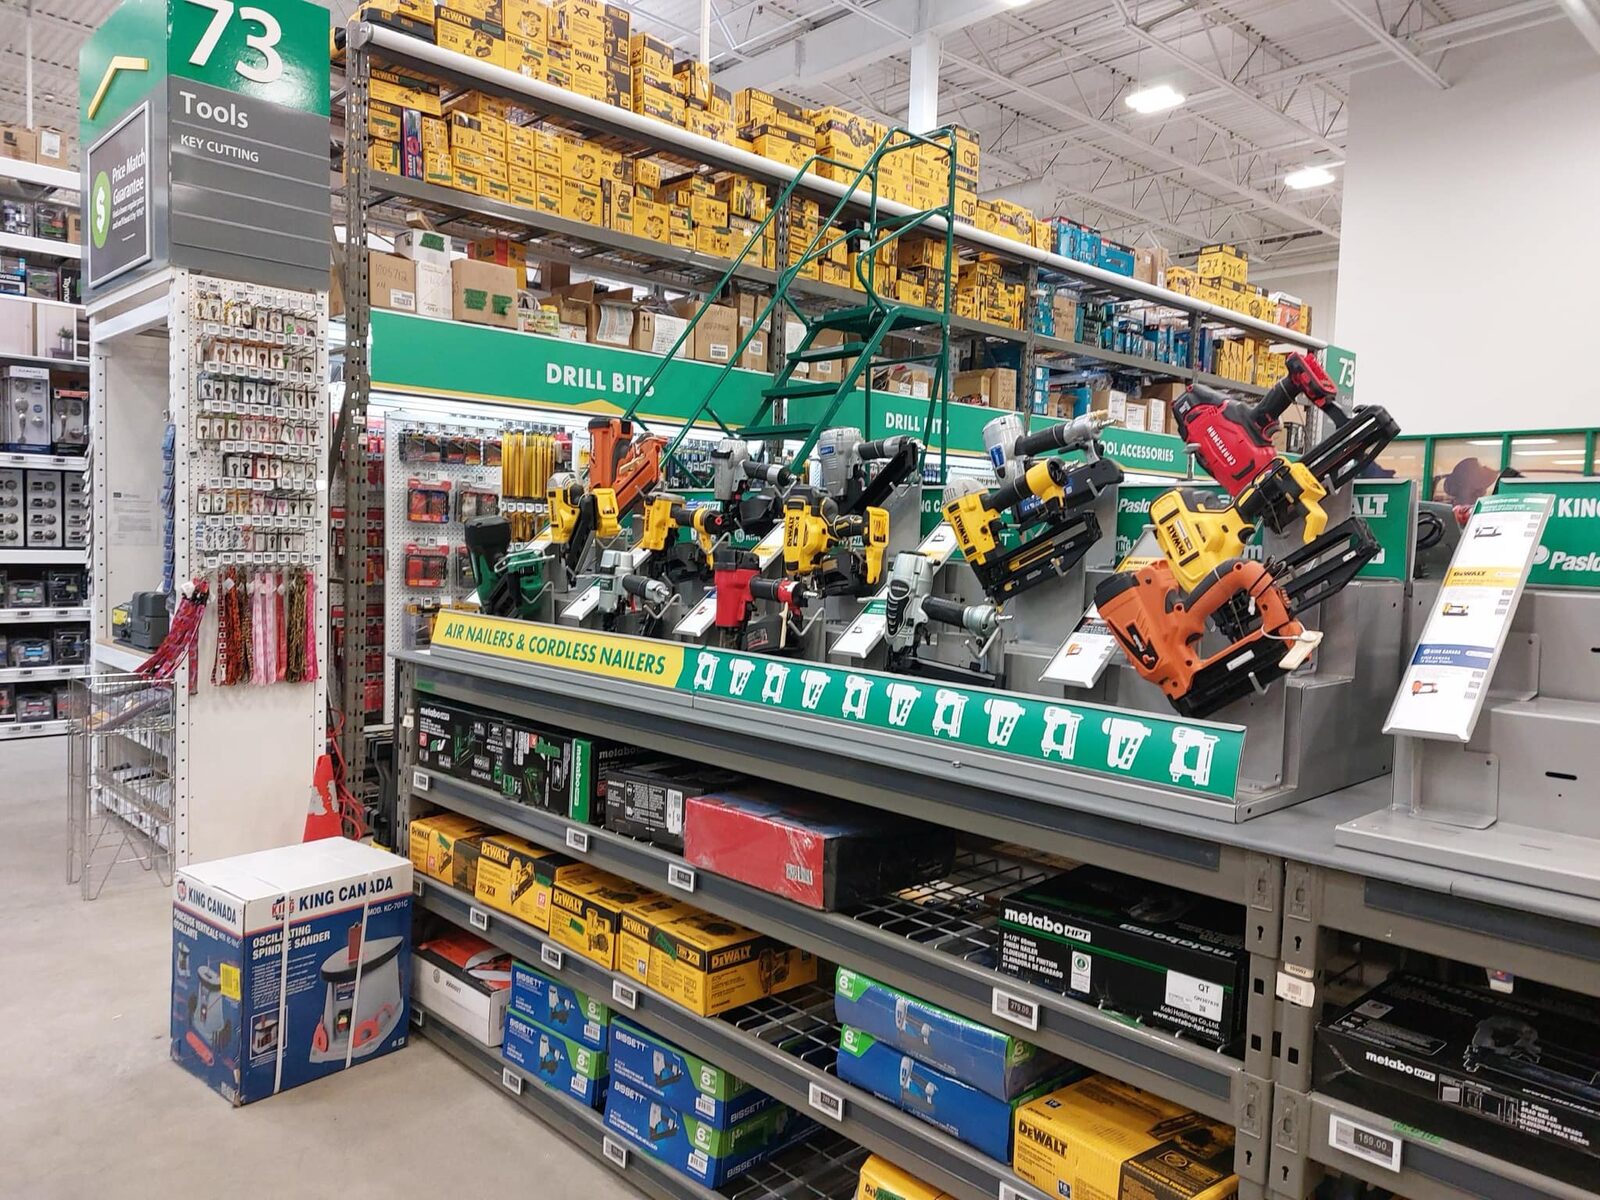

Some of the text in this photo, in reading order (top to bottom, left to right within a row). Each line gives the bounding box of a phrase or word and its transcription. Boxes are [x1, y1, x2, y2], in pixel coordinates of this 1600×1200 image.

[179, 0, 283, 83] 73
[179, 90, 249, 129] Tools
[180, 134, 259, 162] KEY CUTTING
[112, 147, 146, 184] Price Match
[113, 176, 144, 205] Guarantee
[546, 363, 655, 397] DRILL BITS
[1339, 357, 1354, 387] 73
[885, 411, 950, 434] DRILL ITS
[1100, 438, 1174, 463] OOL ACCESSORIES
[1207, 425, 1236, 466] CRAFTSMAN
[1118, 497, 1150, 513] Paslo
[1352, 492, 1388, 516] ALT
[955, 515, 970, 545] DEWALT
[1167, 525, 1185, 556] DEWALT
[444, 623, 666, 675] AIR NAILERS & CORDLESS NAILERS
[481, 841, 510, 864] DEWALT
[189, 887, 237, 925] KING CANADA
[272, 901, 294, 918] KIG
[300, 890, 334, 911] KING
[553, 889, 583, 914] DEWALT
[622, 916, 650, 939] DEWALT
[1005, 908, 1091, 942] metabo HPT
[252, 930, 331, 961] SPINDE SANDER
[712, 945, 751, 969] DEWALT
[1020, 945, 1038, 956] NAILER
[1003, 954, 1031, 969] CLAVADORA
[1031, 963, 1039, 971] DE
[515, 971, 542, 987] BISSETT
[839, 975, 848, 989] 6
[1199, 983, 1211, 994] QT
[1152, 1010, 1220, 1037] www.metabo-hpt.com
[1160, 1004, 1174, 1014] Koki
[1173, 1007, 1198, 1023] Holdings
[509, 1018, 534, 1036] BISSETT
[844, 1030, 854, 1043] 6
[615, 1031, 646, 1052] BISSETT
[1365, 1051, 1414, 1075] metabo
[701, 1073, 711, 1084] 6
[614, 1081, 645, 1103] BISSETT
[730, 1098, 768, 1123] BISSETT
[1537, 1112, 1558, 1123] NAILER
[696, 1129, 706, 1141] 6
[1019, 1118, 1068, 1158] DEWALT
[1552, 1129, 1569, 1139] PARA
[726, 1153, 763, 1178] BISSETT
